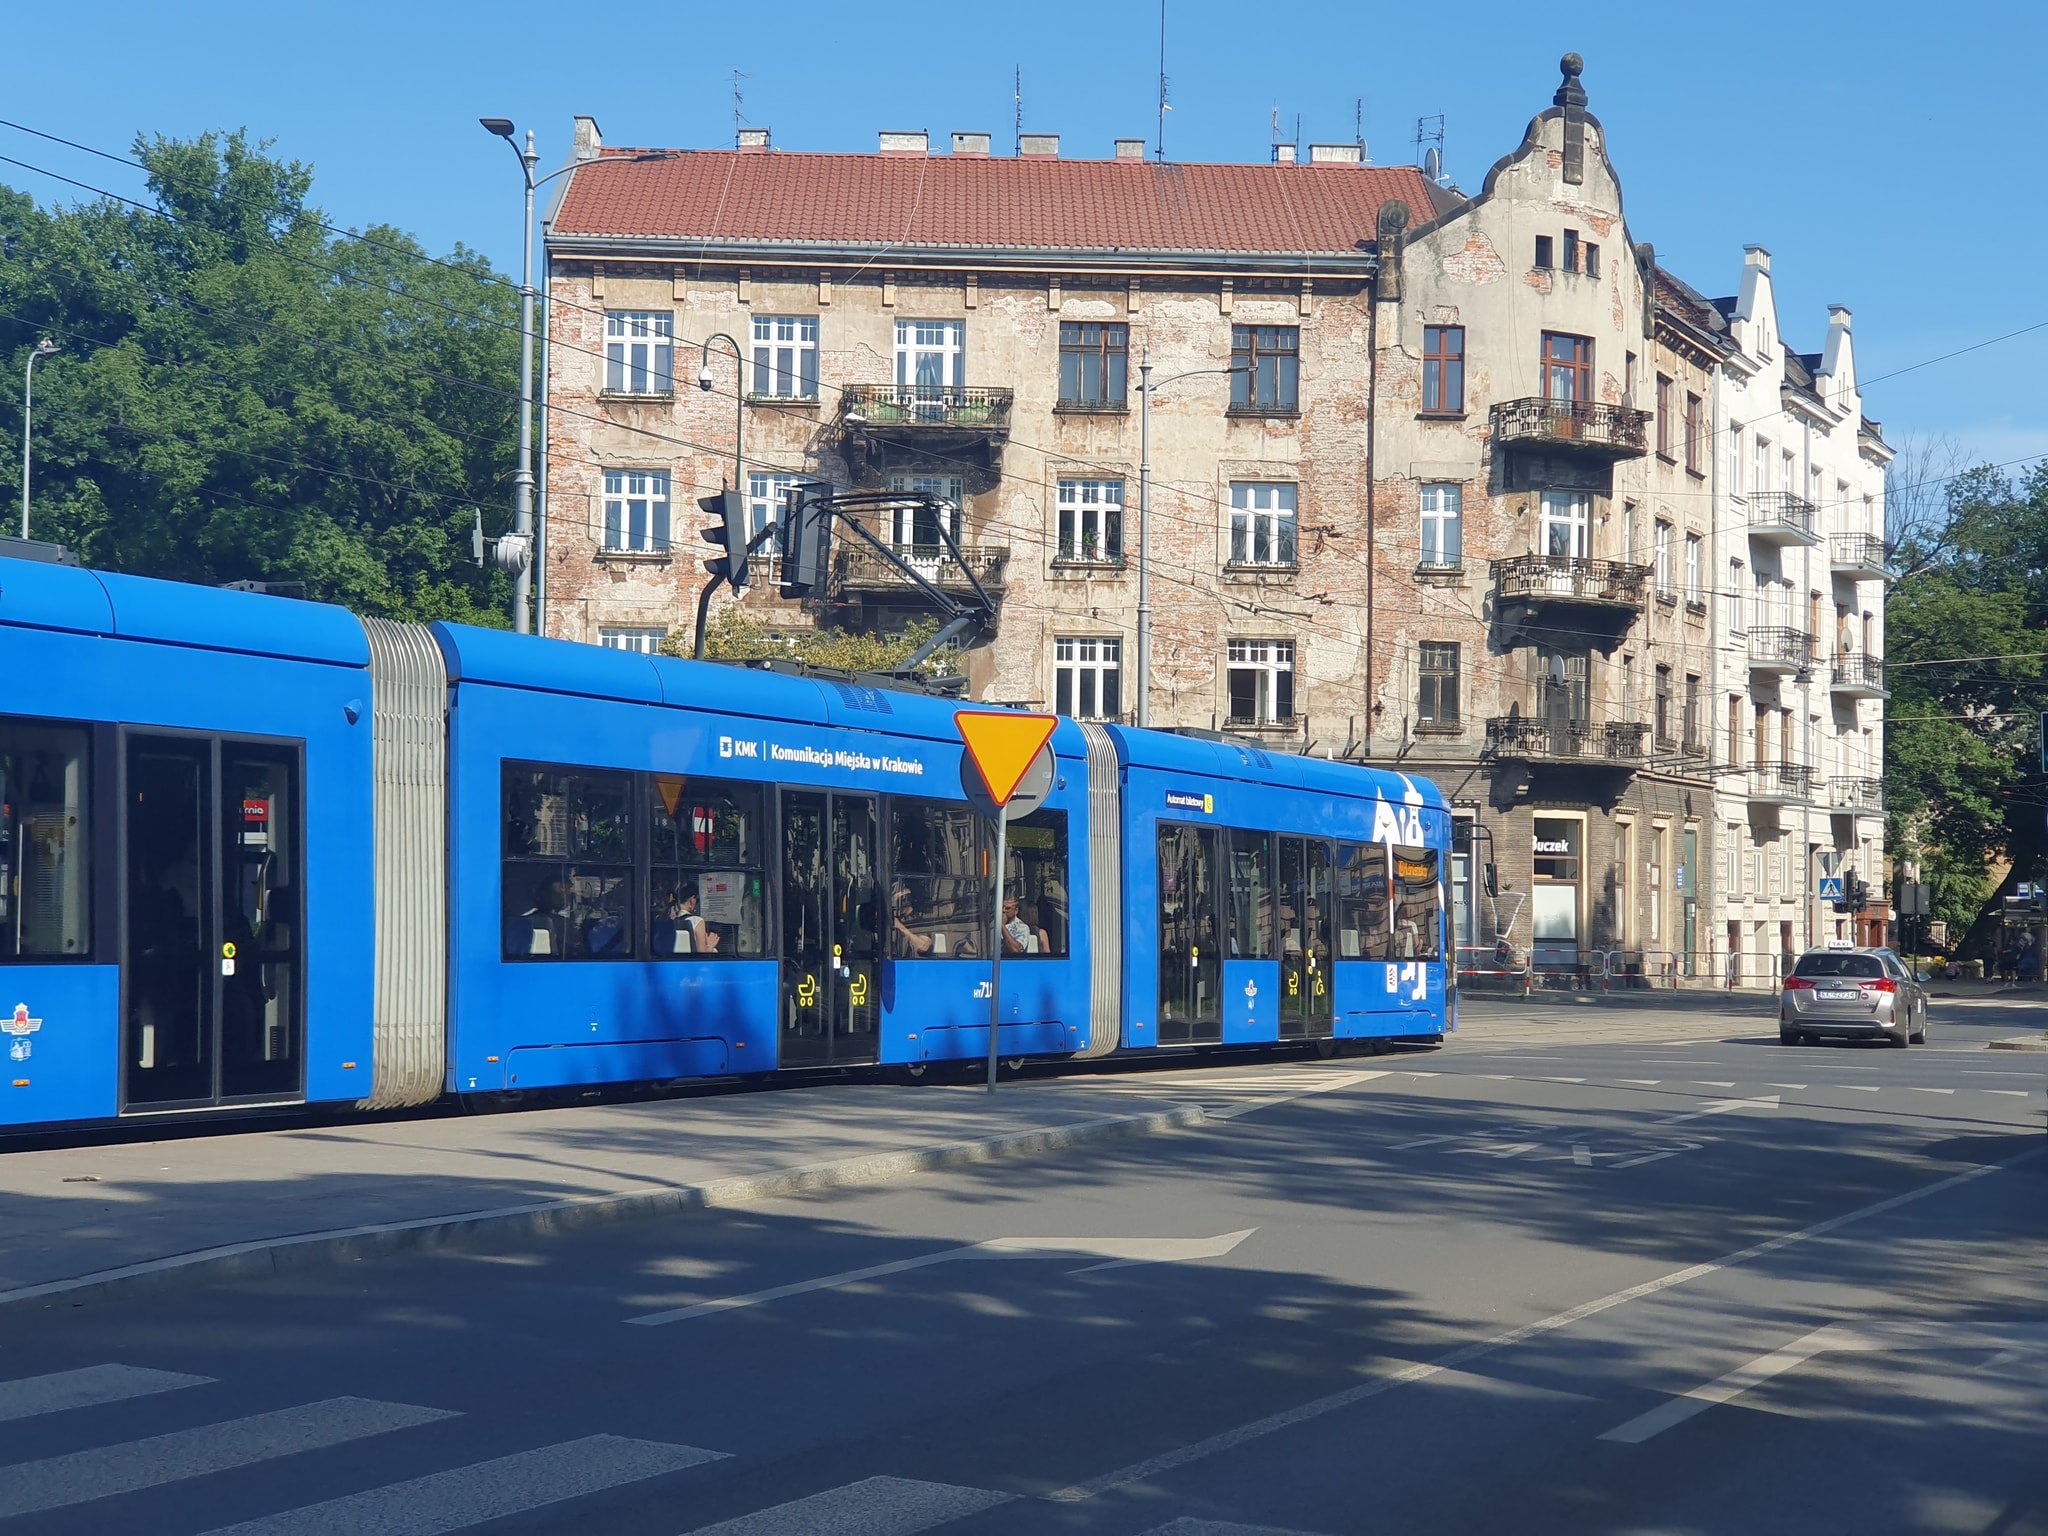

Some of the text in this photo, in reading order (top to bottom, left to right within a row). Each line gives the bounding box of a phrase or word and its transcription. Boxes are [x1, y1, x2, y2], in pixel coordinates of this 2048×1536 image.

[734, 740, 924, 775] KMK Komunikacja Miejska w Krakowie
